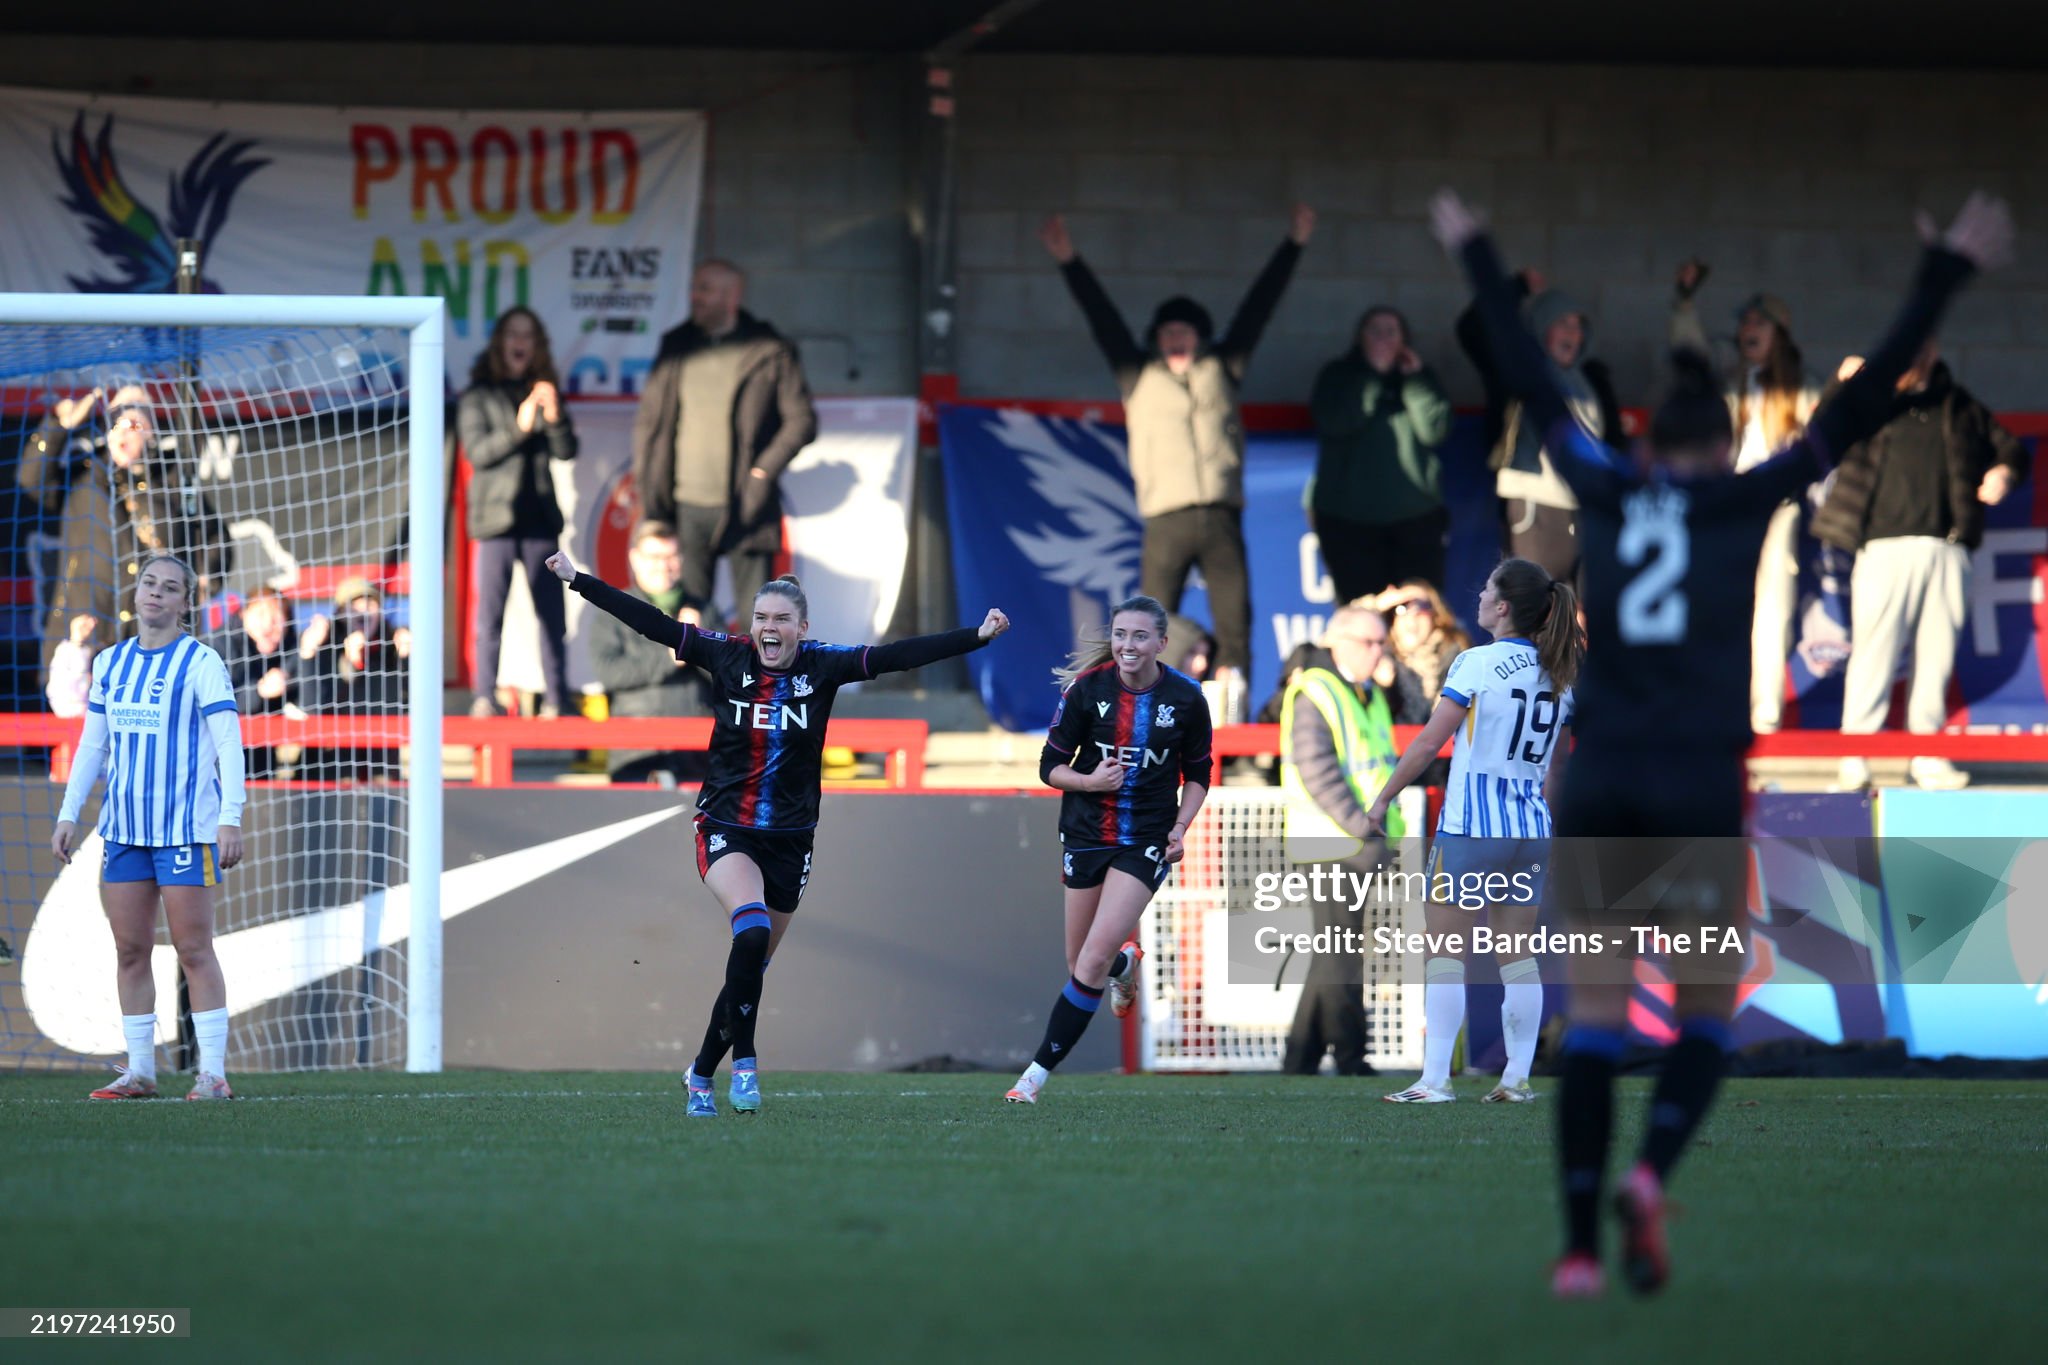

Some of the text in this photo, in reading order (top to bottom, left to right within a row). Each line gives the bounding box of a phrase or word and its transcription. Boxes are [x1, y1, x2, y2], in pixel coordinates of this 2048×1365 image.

[350, 123, 641, 226] PROUD
[571, 247, 661, 279] FANS
[364, 237, 531, 339] AND
[1616, 516, 1692, 646] 2
[111, 708, 160, 719] AMERICAN
[117, 719, 160, 727] EXPRESS
[729, 699, 808, 730] TEN
[1507, 688, 1560, 764] 19
[1095, 741, 1169, 769] TEN
